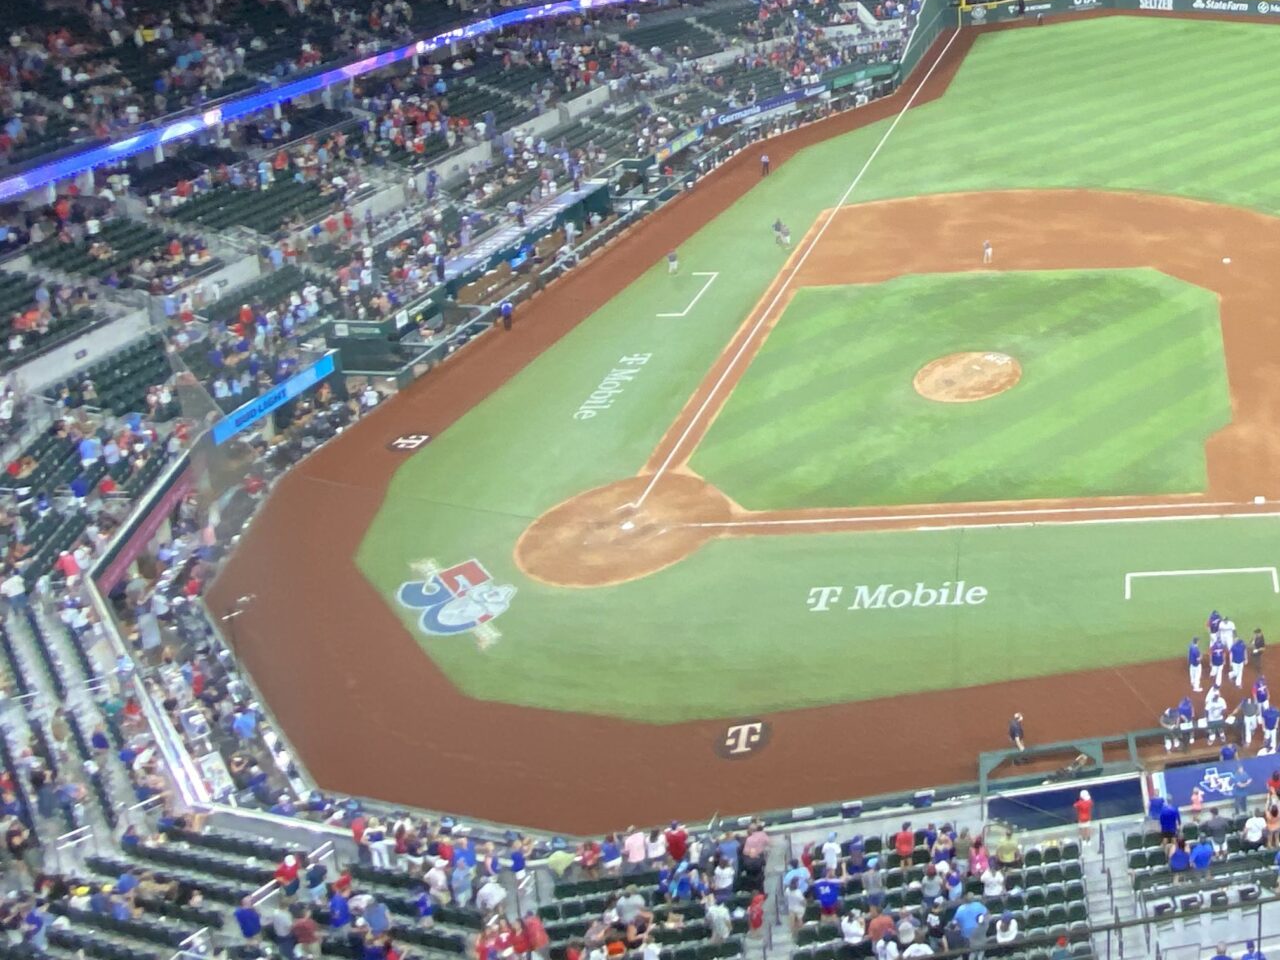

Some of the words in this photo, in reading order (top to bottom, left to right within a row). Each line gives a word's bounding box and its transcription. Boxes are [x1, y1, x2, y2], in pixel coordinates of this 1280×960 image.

[718, 104, 761, 125] Germania
[619, 352, 653, 365] T
[572, 367, 641, 420] Mobile
[392, 435, 430, 450] T
[805, 585, 843, 611] T
[848, 579, 988, 610] Mobile
[726, 721, 762, 754] T
